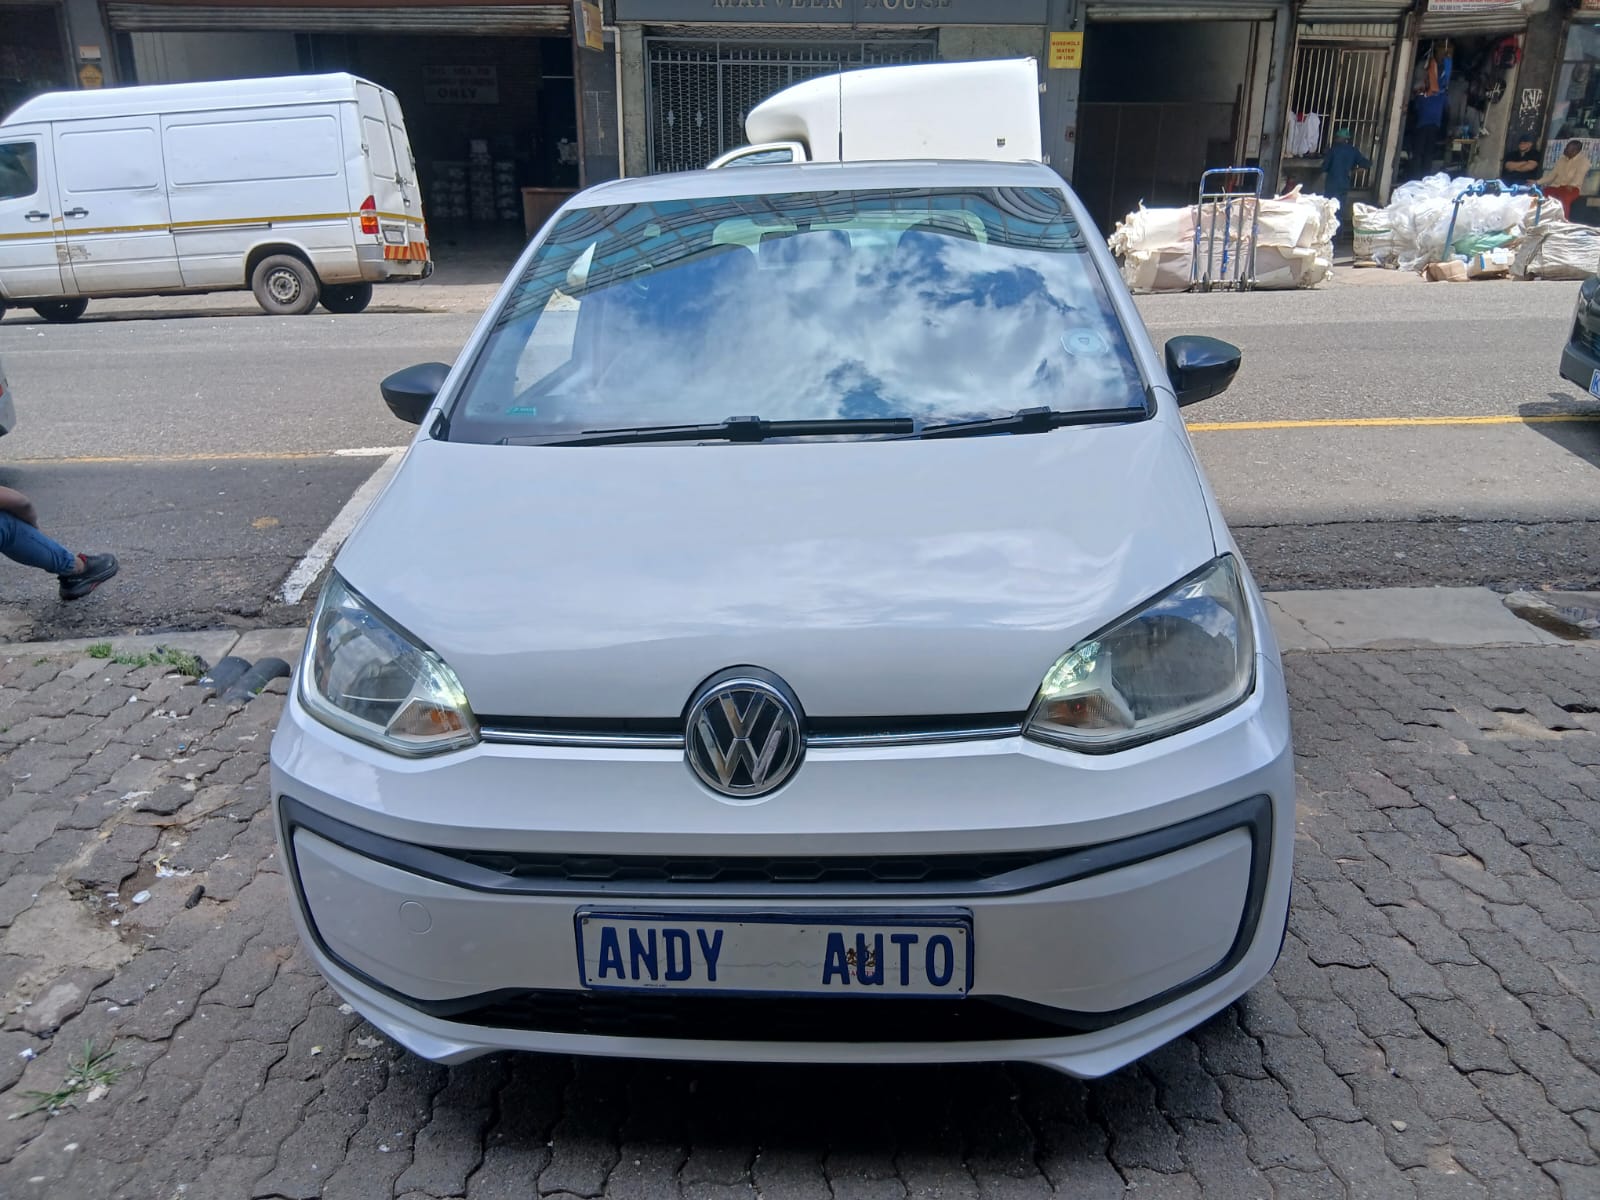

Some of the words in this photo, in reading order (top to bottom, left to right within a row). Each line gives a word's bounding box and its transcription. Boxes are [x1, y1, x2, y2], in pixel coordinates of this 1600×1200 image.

[438, 87, 477, 99] ONLY
[695, 687, 788, 790] VW
[599, 927, 724, 982] ANDY
[822, 932, 954, 987] AUTO
